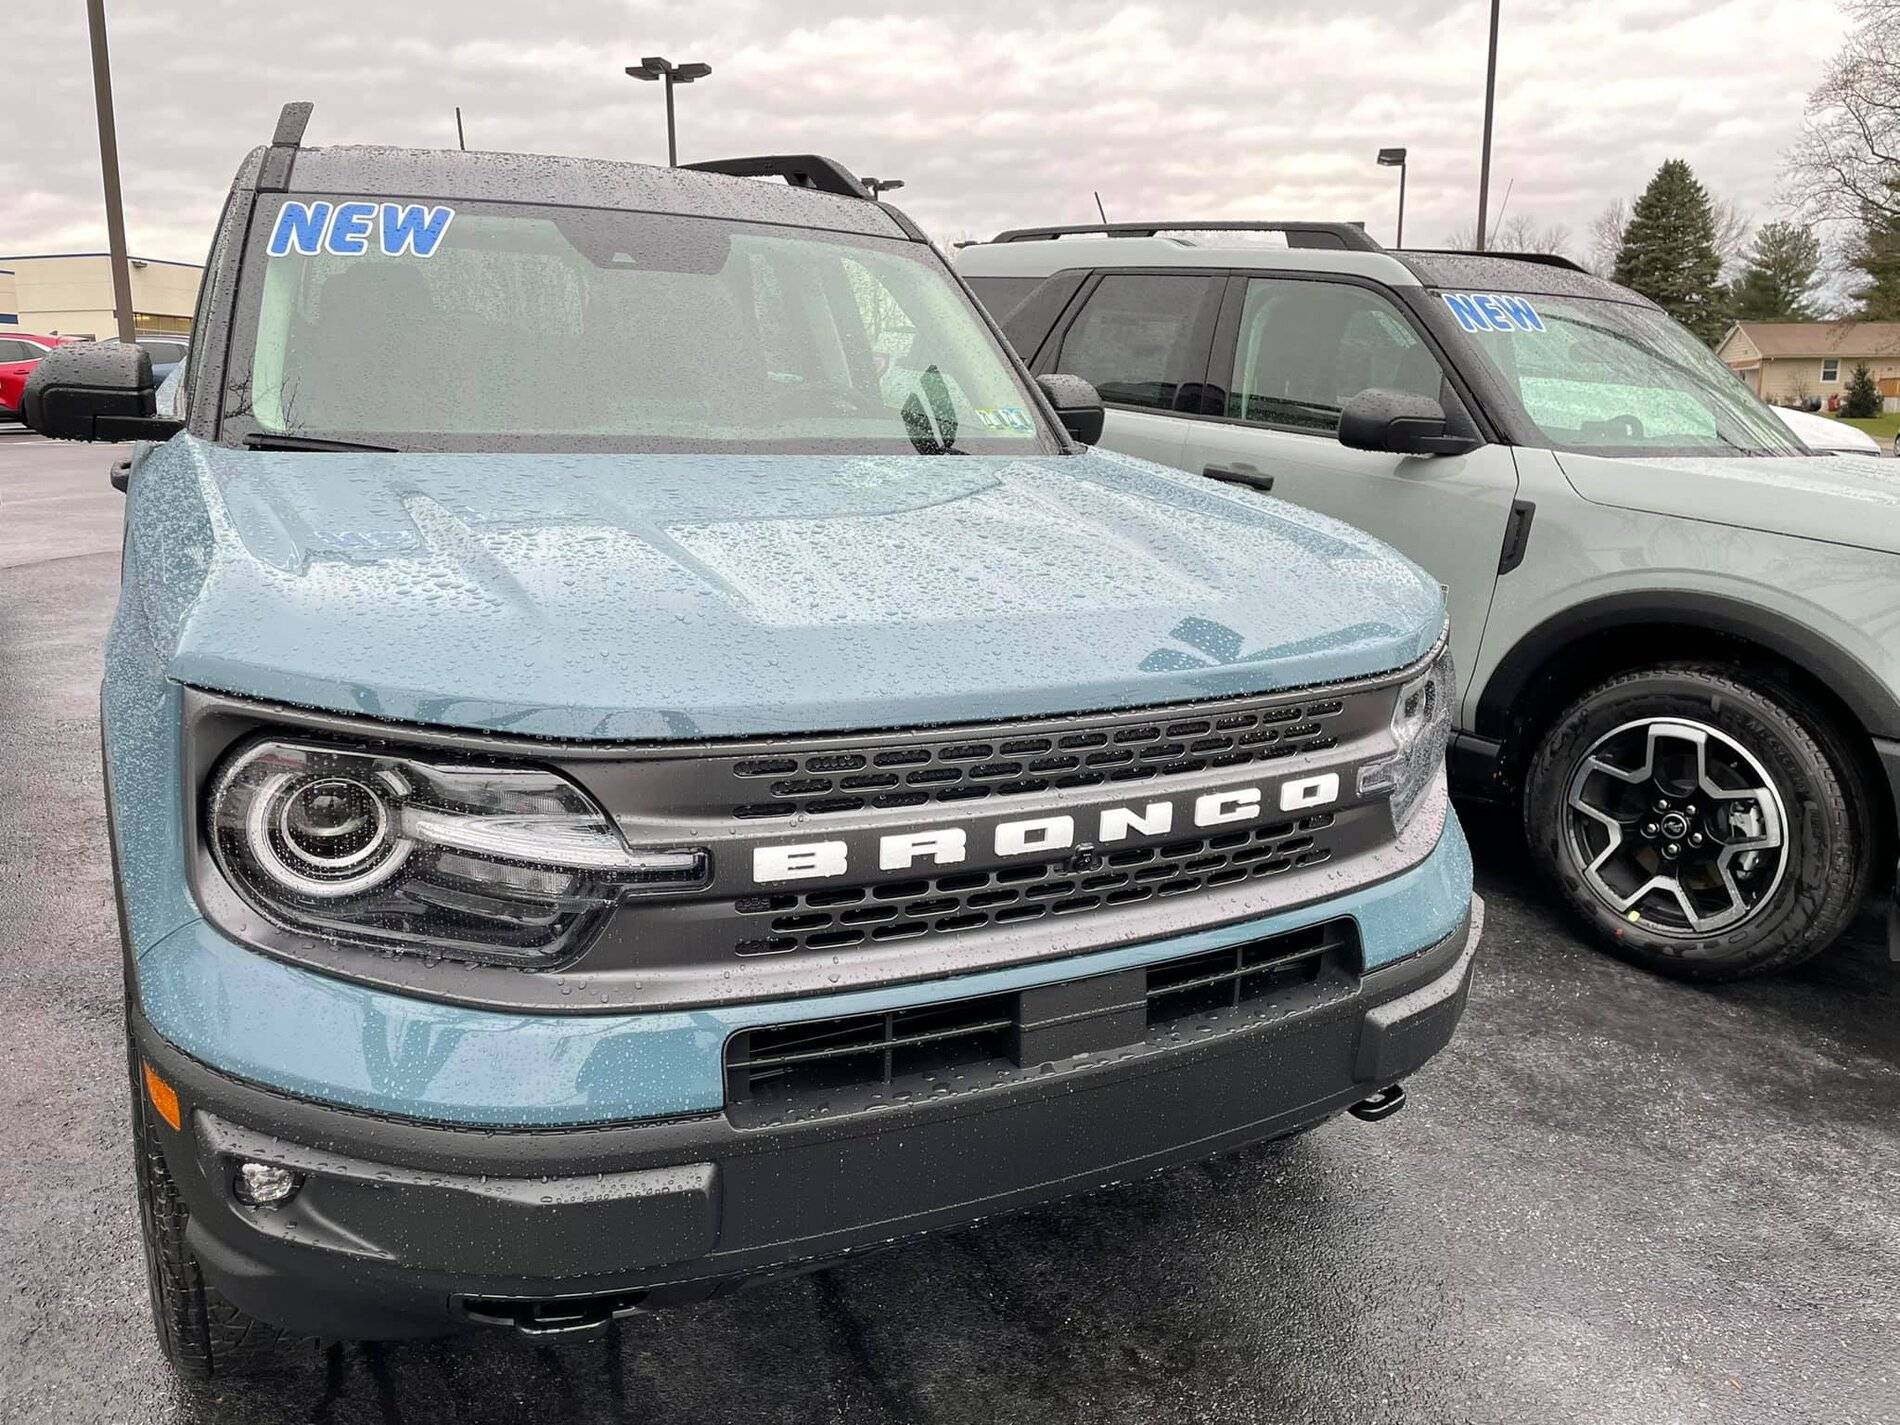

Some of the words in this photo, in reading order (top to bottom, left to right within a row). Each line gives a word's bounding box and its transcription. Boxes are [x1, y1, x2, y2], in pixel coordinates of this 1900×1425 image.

[267, 201, 455, 257] NEW
[1441, 293, 1546, 332] NEW
[752, 773, 1339, 883] BRONCO
